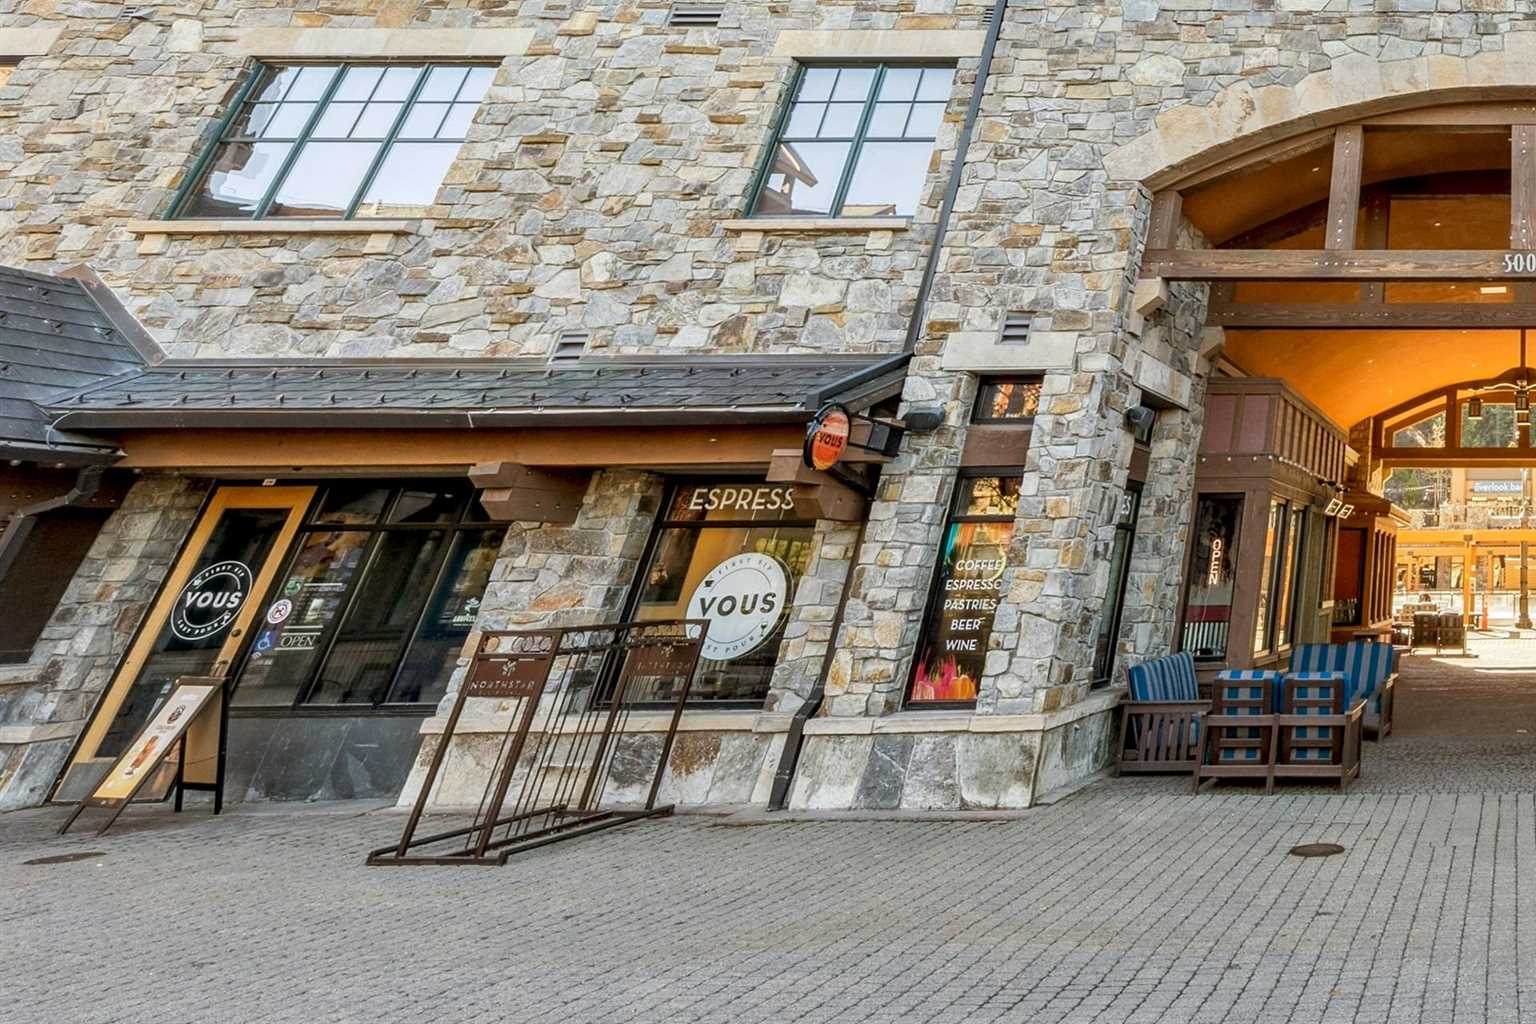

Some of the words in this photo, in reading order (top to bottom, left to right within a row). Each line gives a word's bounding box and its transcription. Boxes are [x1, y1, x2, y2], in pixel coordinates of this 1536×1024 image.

[819, 432, 844, 449] VOUS
[955, 559, 1003, 571] COFFEE
[1208, 538, 1222, 585] OPEN
[185, 591, 243, 609] VOUS
[699, 592, 777, 617] VOUS
[943, 598, 998, 611] PASTRIES
[950, 619, 982, 631] BEER
[280, 635, 316, 647] OPEN
[946, 639, 978, 651] WINE
